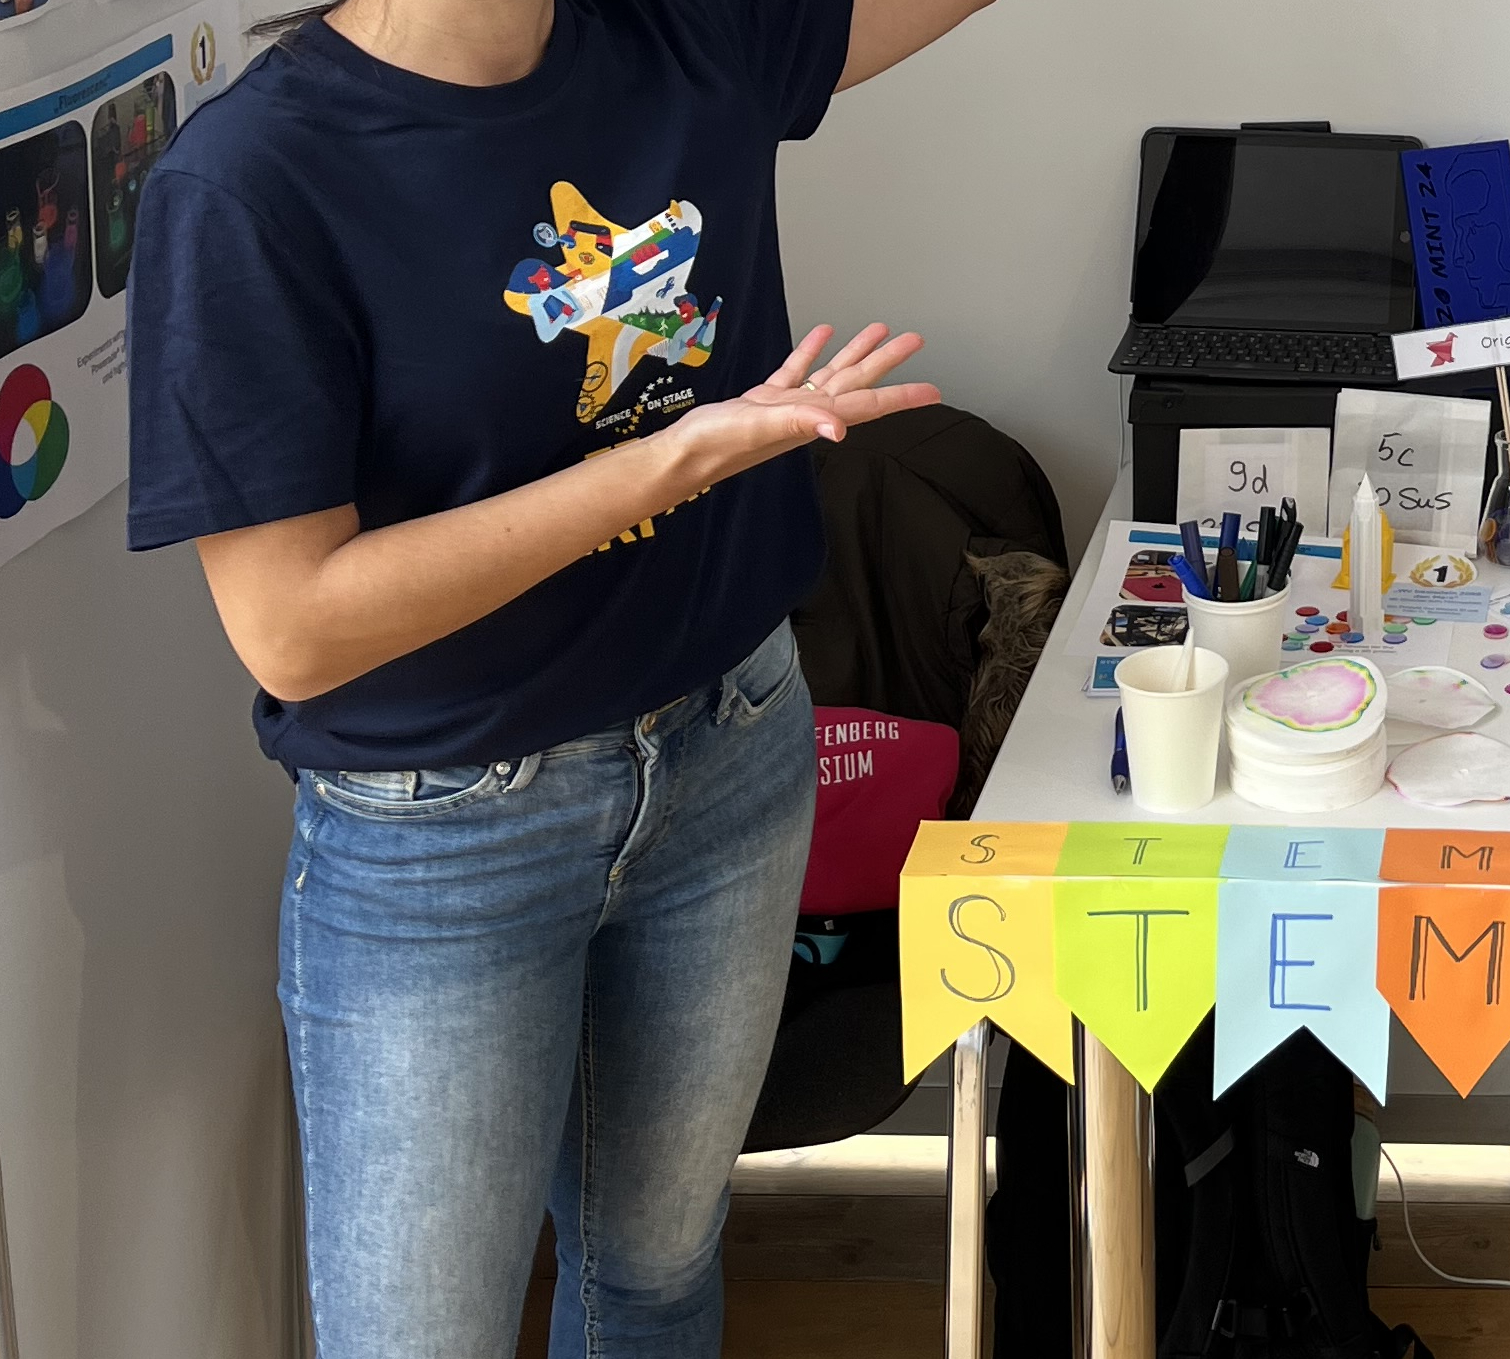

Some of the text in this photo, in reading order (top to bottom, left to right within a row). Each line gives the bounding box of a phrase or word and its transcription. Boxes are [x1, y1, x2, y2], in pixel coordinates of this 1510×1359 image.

[199, 35, 207, 69] 1
[1416, 161, 1438, 199] 24
[1422, 206, 1449, 279] MINT
[595, 387, 694, 430] SCIENCE ON STAGE
[1378, 432, 1415, 467] 5c
[1228, 460, 1269, 494] 9d
[1433, 565, 1449, 583] 1
[818, 750, 874, 785] SIUM
